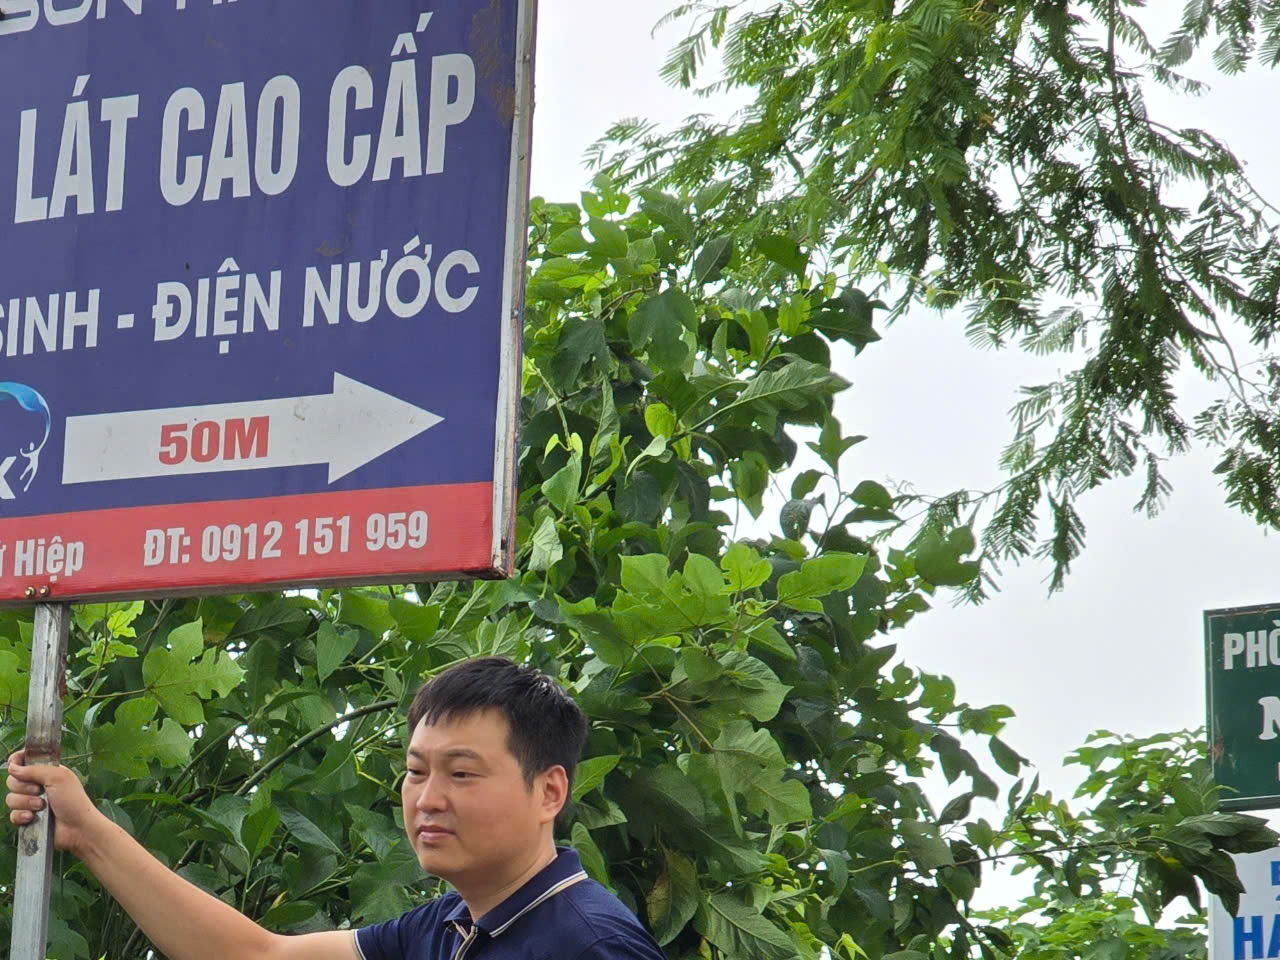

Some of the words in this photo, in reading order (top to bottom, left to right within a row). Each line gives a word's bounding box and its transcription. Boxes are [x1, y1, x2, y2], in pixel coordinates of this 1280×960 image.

[14, 74, 139, 224] LÁT
[159, 75, 301, 206] CAO
[326, 12, 476, 187] CẤP
[152, 257, 282, 354] ĐIỆN
[302, 235, 480, 327] NƯỚC
[158, 415, 270, 466] 50M
[14, 536, 85, 582] Hiệp
[143, 527, 191, 566] ĐT:
[201, 520, 283, 563] 0912
[295, 515, 351, 555] 151
[366, 510, 429, 551] 959
